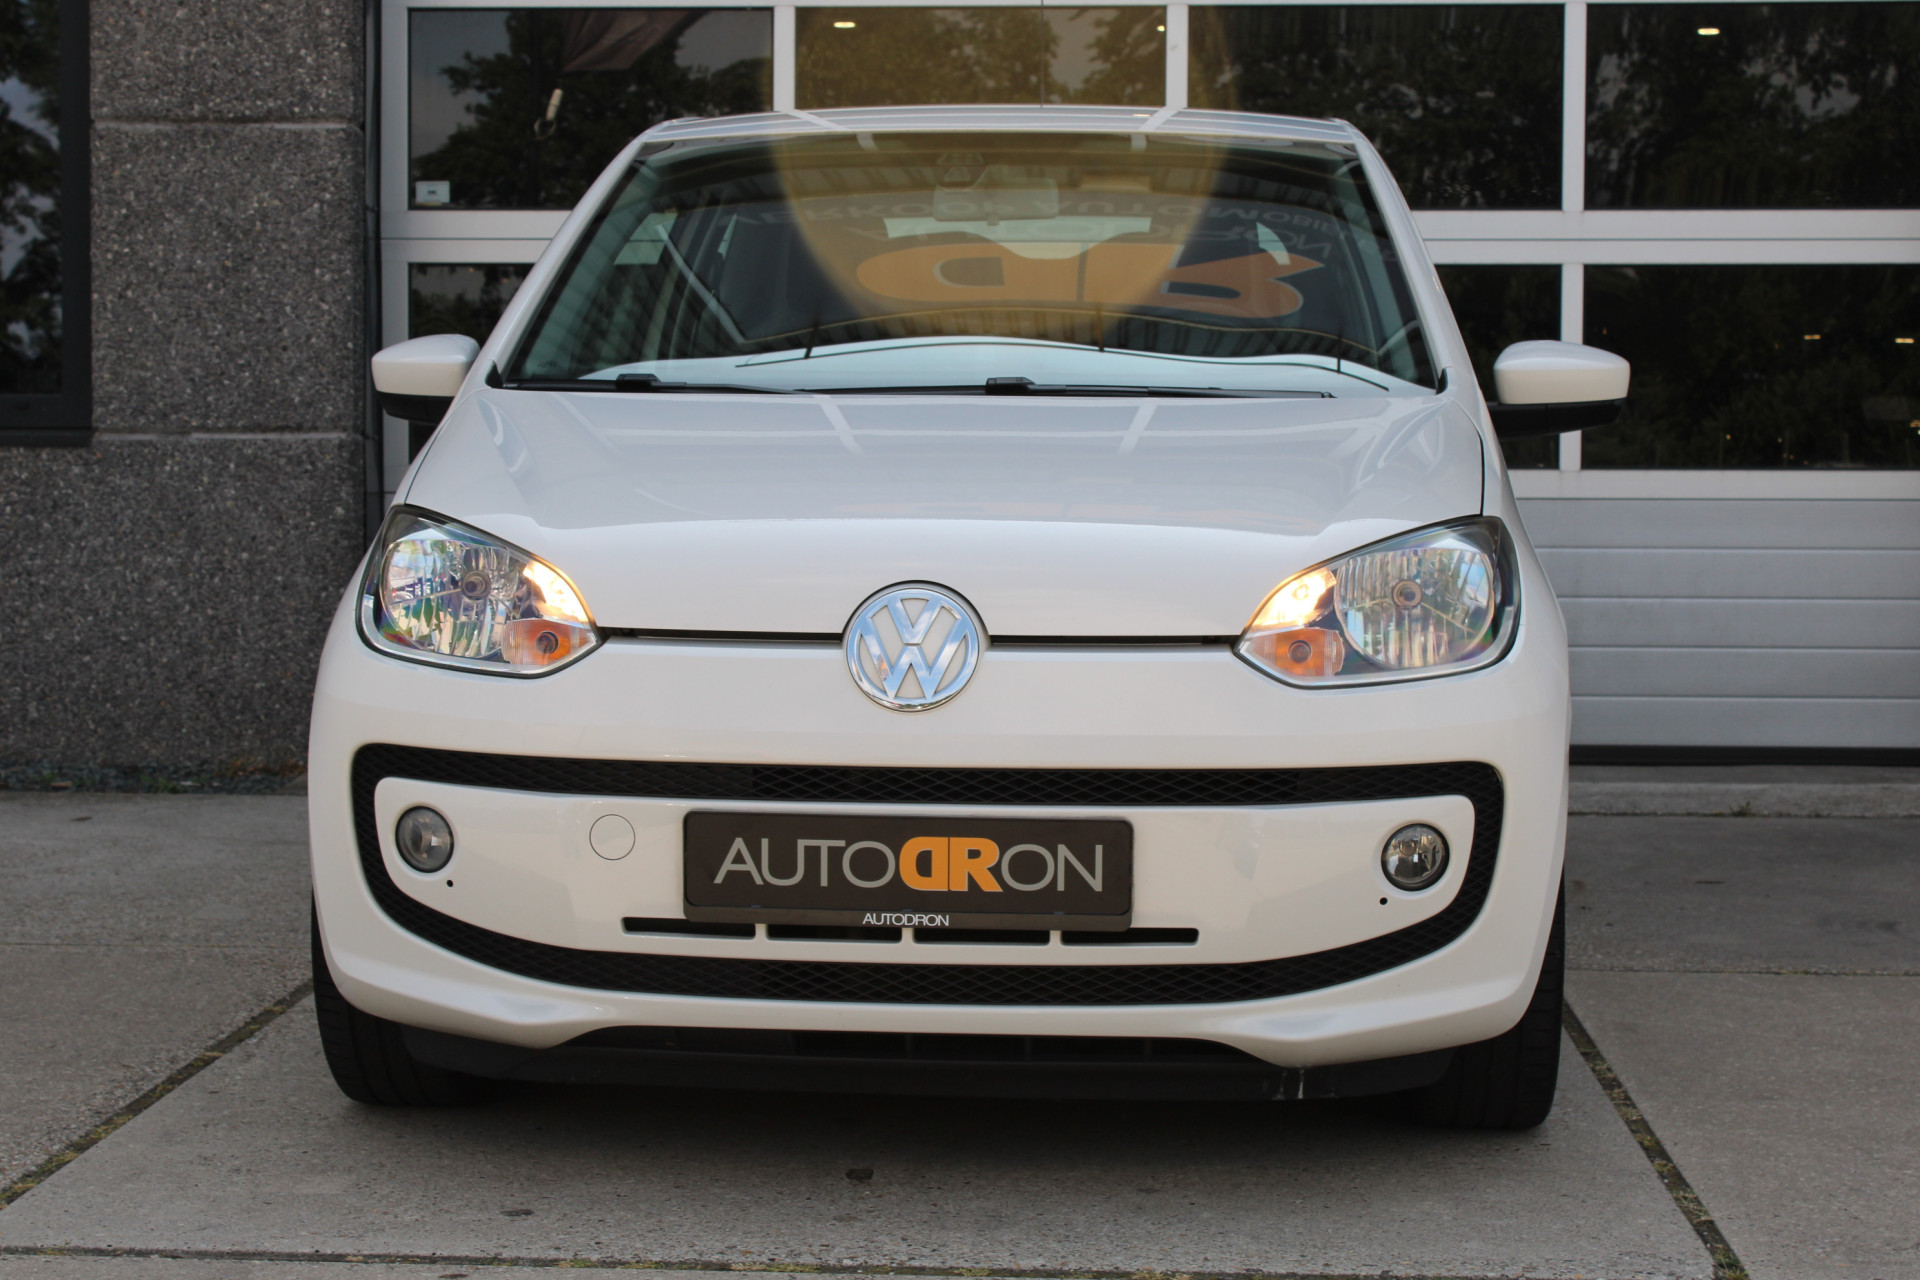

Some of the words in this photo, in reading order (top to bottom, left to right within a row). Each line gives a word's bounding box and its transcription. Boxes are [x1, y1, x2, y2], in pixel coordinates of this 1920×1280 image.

[850, 590, 976, 708] VW
[713, 836, 1103, 893] AUTODRON
[862, 912, 949, 927] AUTODRON
